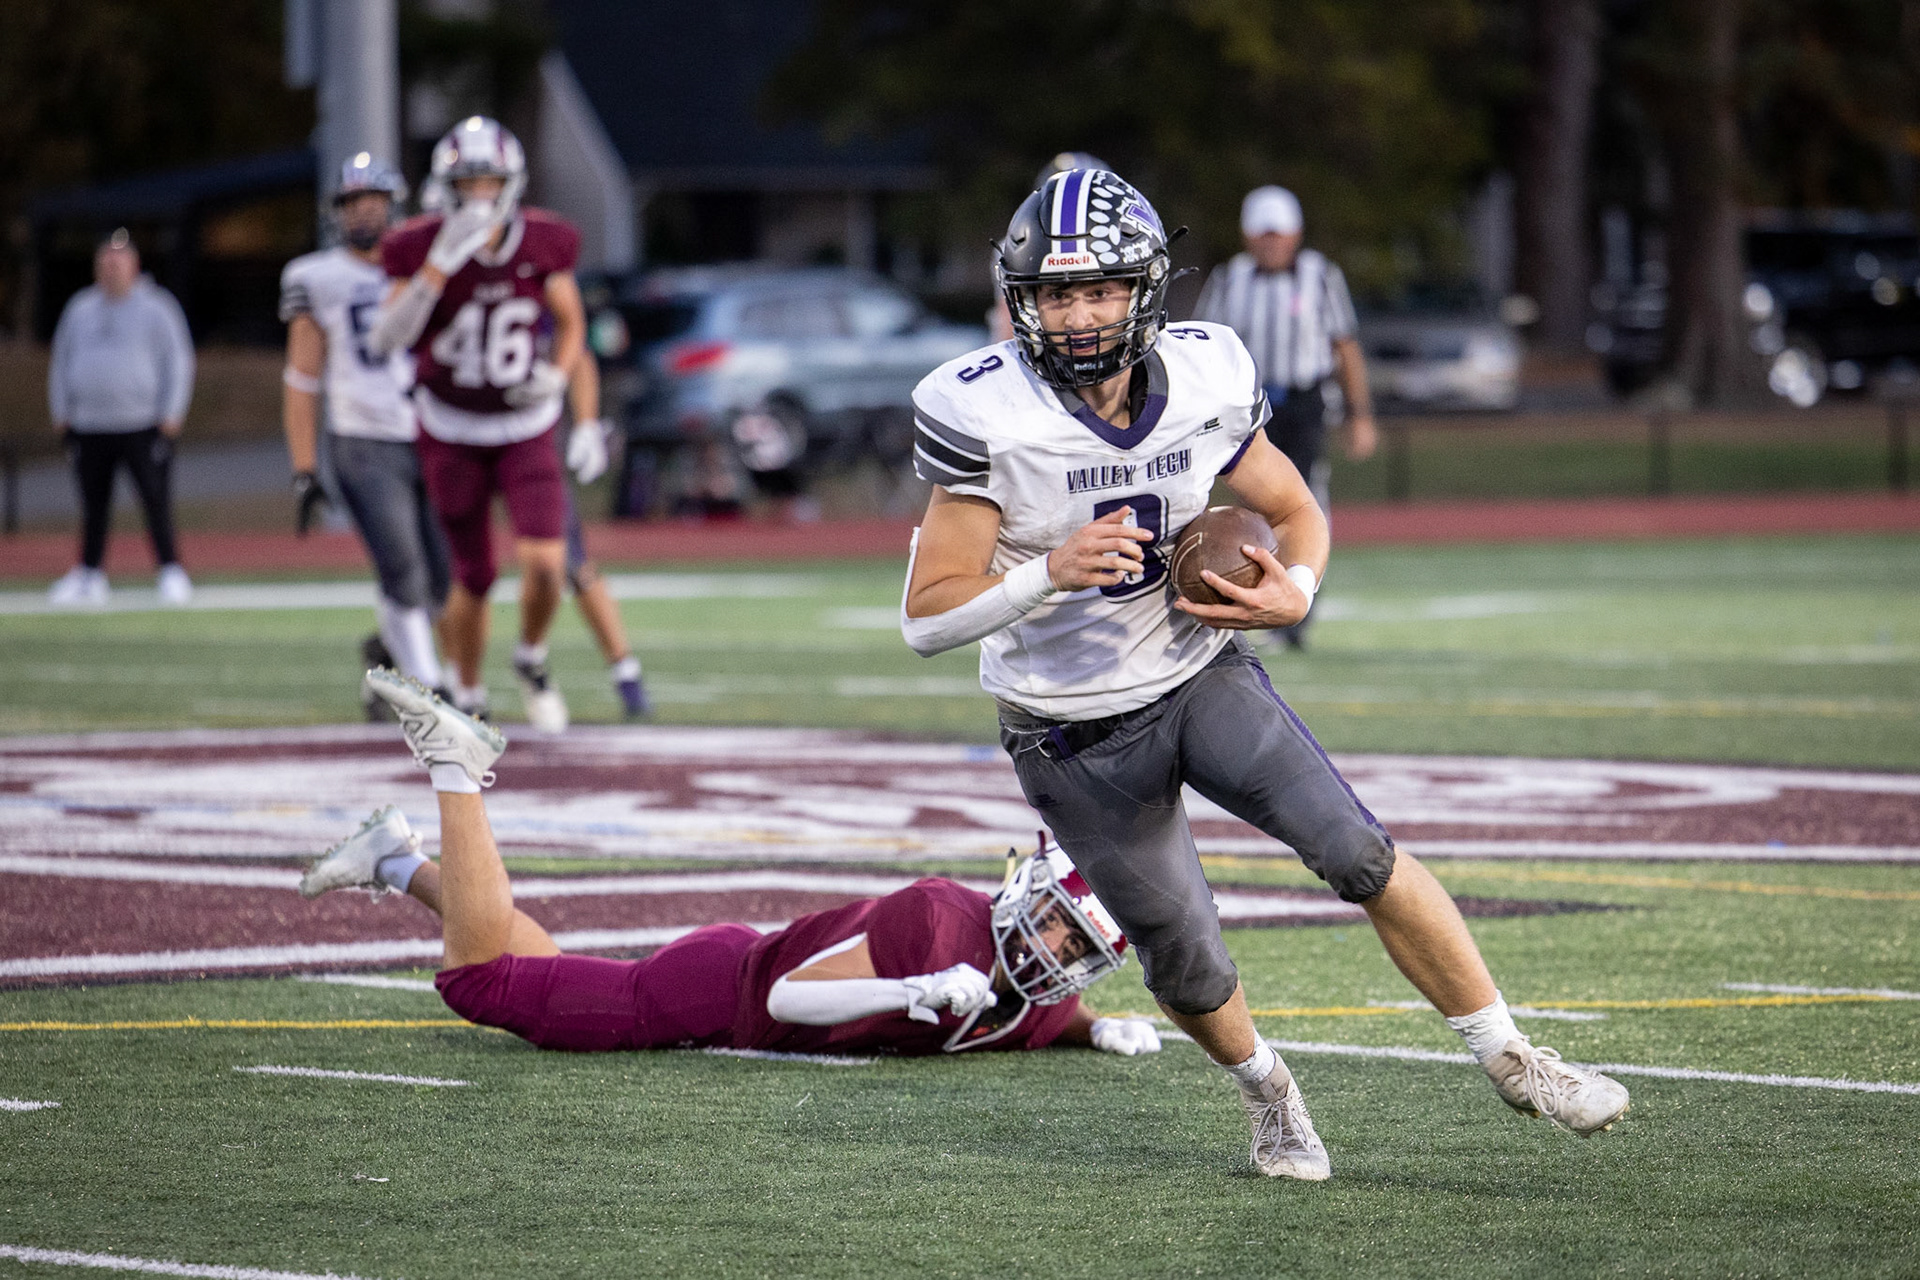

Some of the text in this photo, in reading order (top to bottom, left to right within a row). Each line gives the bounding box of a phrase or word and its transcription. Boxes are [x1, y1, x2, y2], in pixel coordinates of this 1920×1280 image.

[1047, 256, 1090, 266] Riddell
[431, 298, 540, 388] 46
[956, 355, 1003, 384] 3
[1066, 448, 1191, 494] VALLEY TECH
